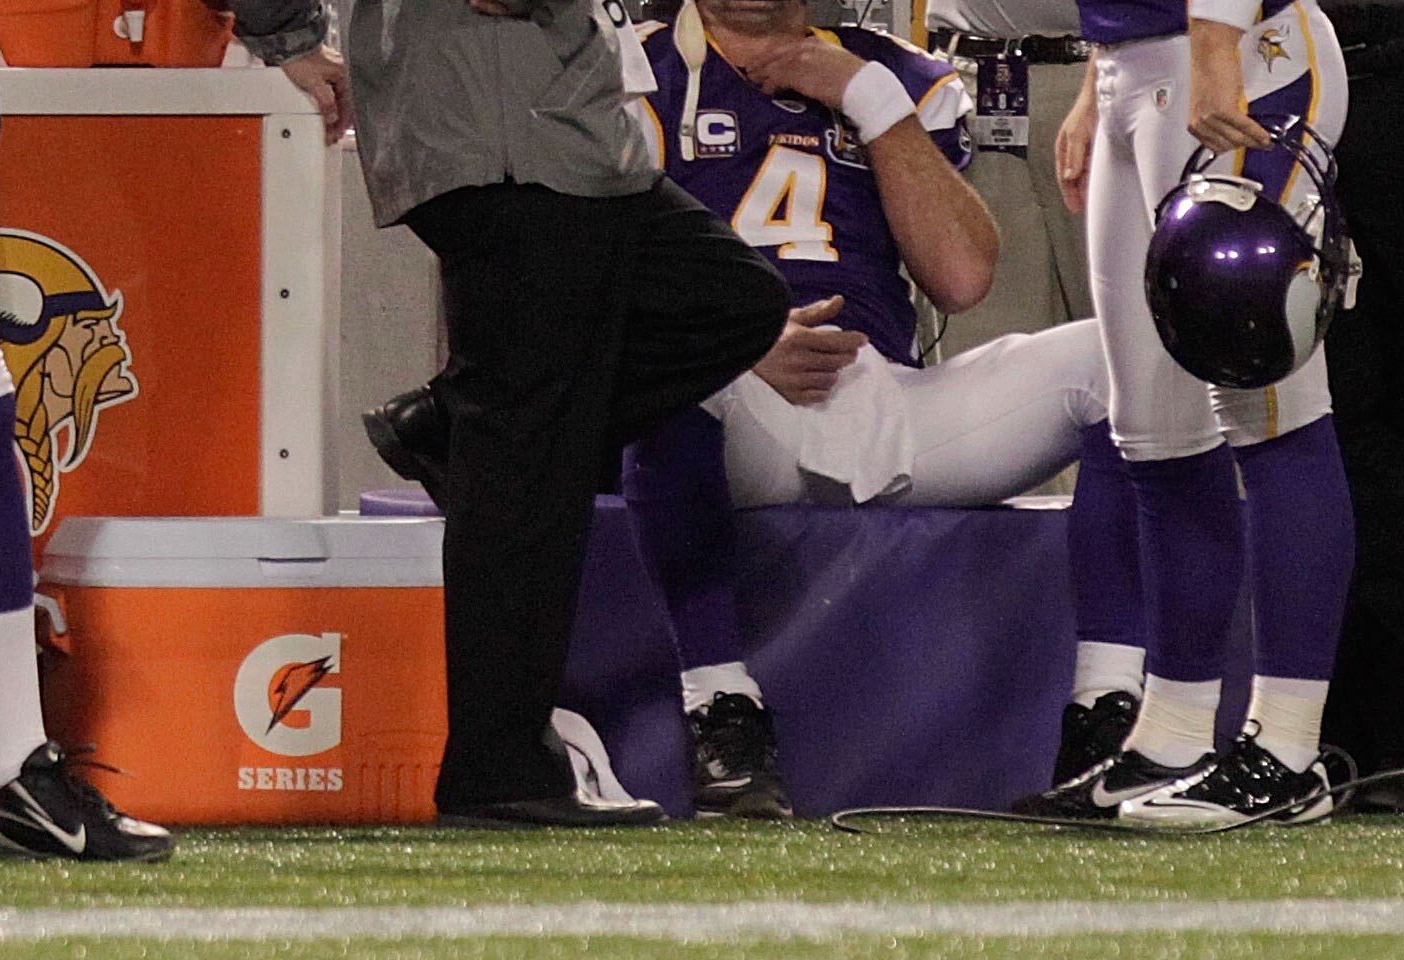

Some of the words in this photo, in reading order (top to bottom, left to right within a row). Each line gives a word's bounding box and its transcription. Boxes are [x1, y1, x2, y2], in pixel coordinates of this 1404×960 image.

[697, 112, 737, 146] C
[731, 144, 840, 262] 4
[233, 632, 343, 757] G
[237, 767, 344, 791] SERIES
